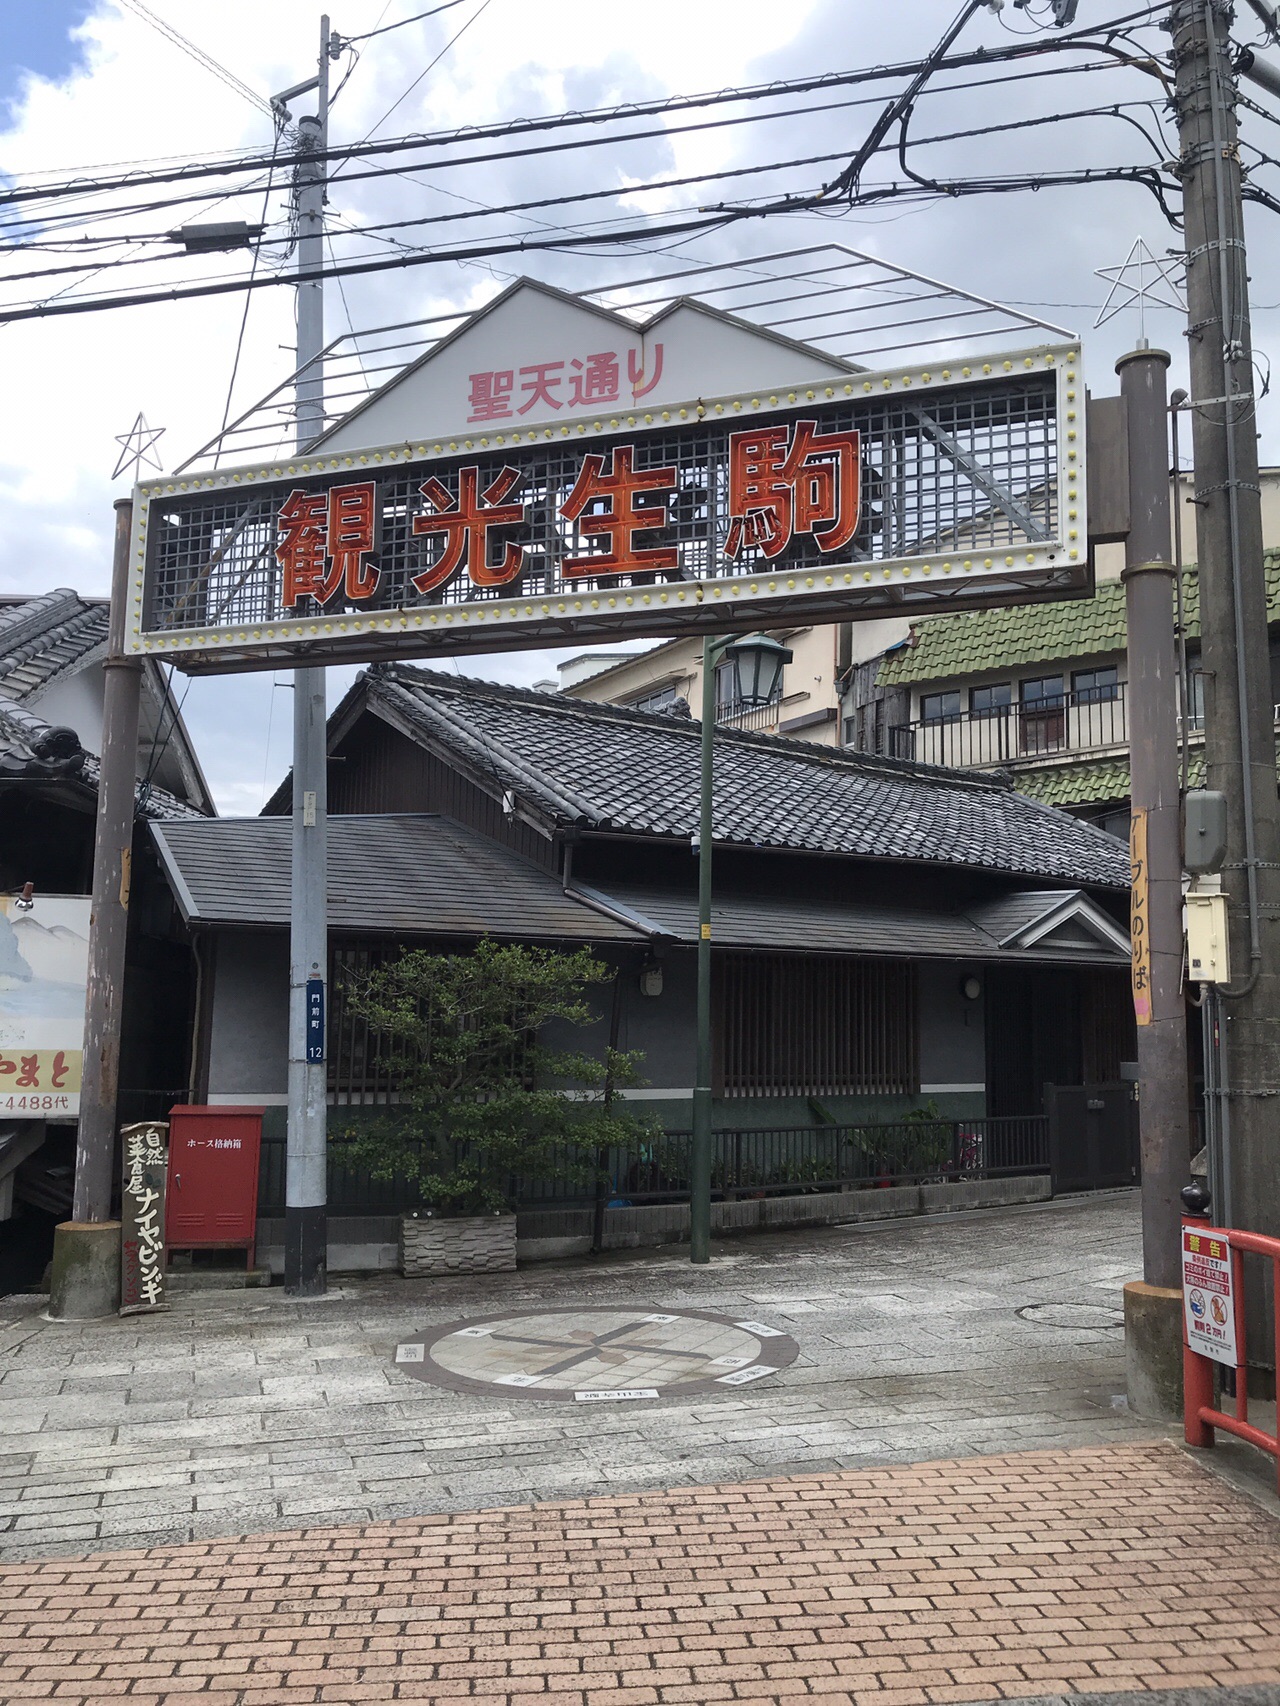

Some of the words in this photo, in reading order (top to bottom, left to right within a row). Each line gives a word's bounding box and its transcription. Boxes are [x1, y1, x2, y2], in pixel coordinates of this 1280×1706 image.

[467, 344, 664, 423] 聖天通り
[275, 420, 861, 608] 観光生駒
[311, 993, 320, 1029] 門前町
[309, 1047, 322, 1058] 12
[146, 1127, 163, 1165] 自然
[187, 1138, 242, 1149] ホース格納箱
[124, 1134, 147, 1194] 菜食屋
[134, 1188, 163, 1304] ナイヤビンギ
[1189, 1234, 1221, 1258] 警告
